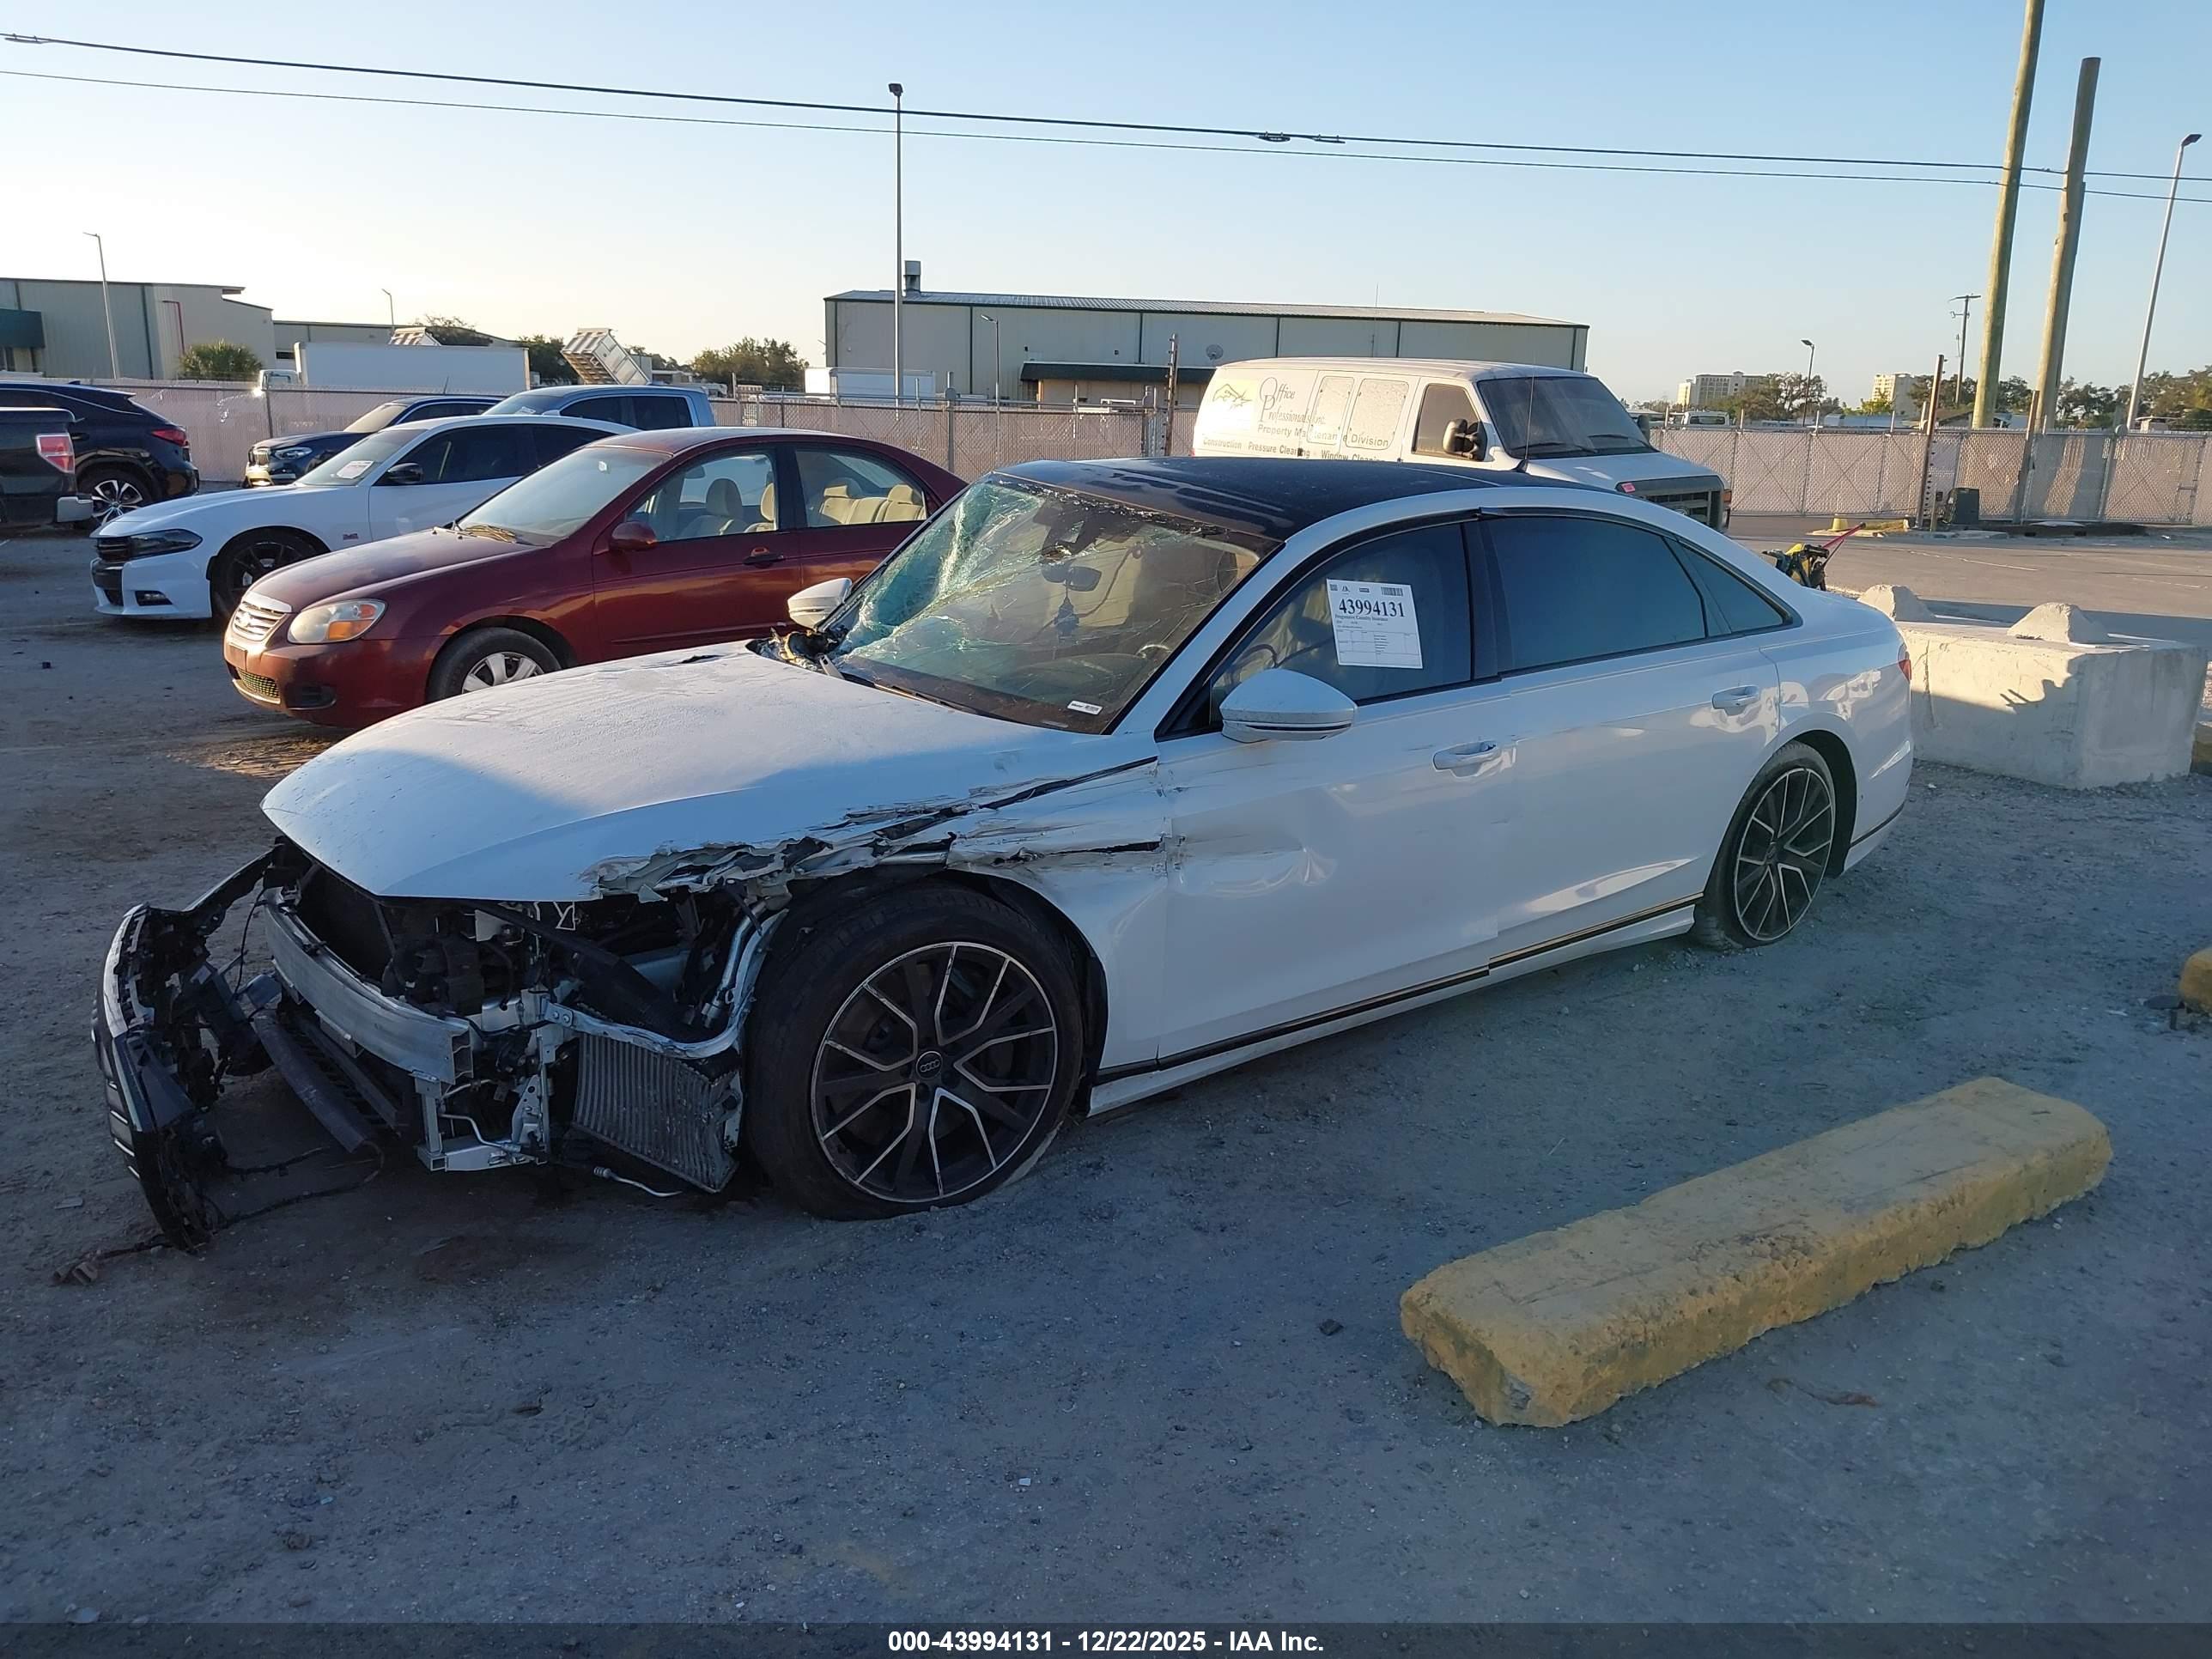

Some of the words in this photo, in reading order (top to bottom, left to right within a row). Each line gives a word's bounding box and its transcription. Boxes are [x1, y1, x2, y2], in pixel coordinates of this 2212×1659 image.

[1260, 377, 1295, 402] Office
[1258, 424, 1292, 437] Property
[1294, 427, 1348, 442] Matenane
[1351, 434, 1389, 447] Division
[1203, 439, 1243, 450] Construction
[1248, 441, 1277, 453] Pressure
[1279, 445, 1310, 459] Cleanng
[1321, 449, 1349, 460] Window
[1339, 599, 1405, 617] 43994131
